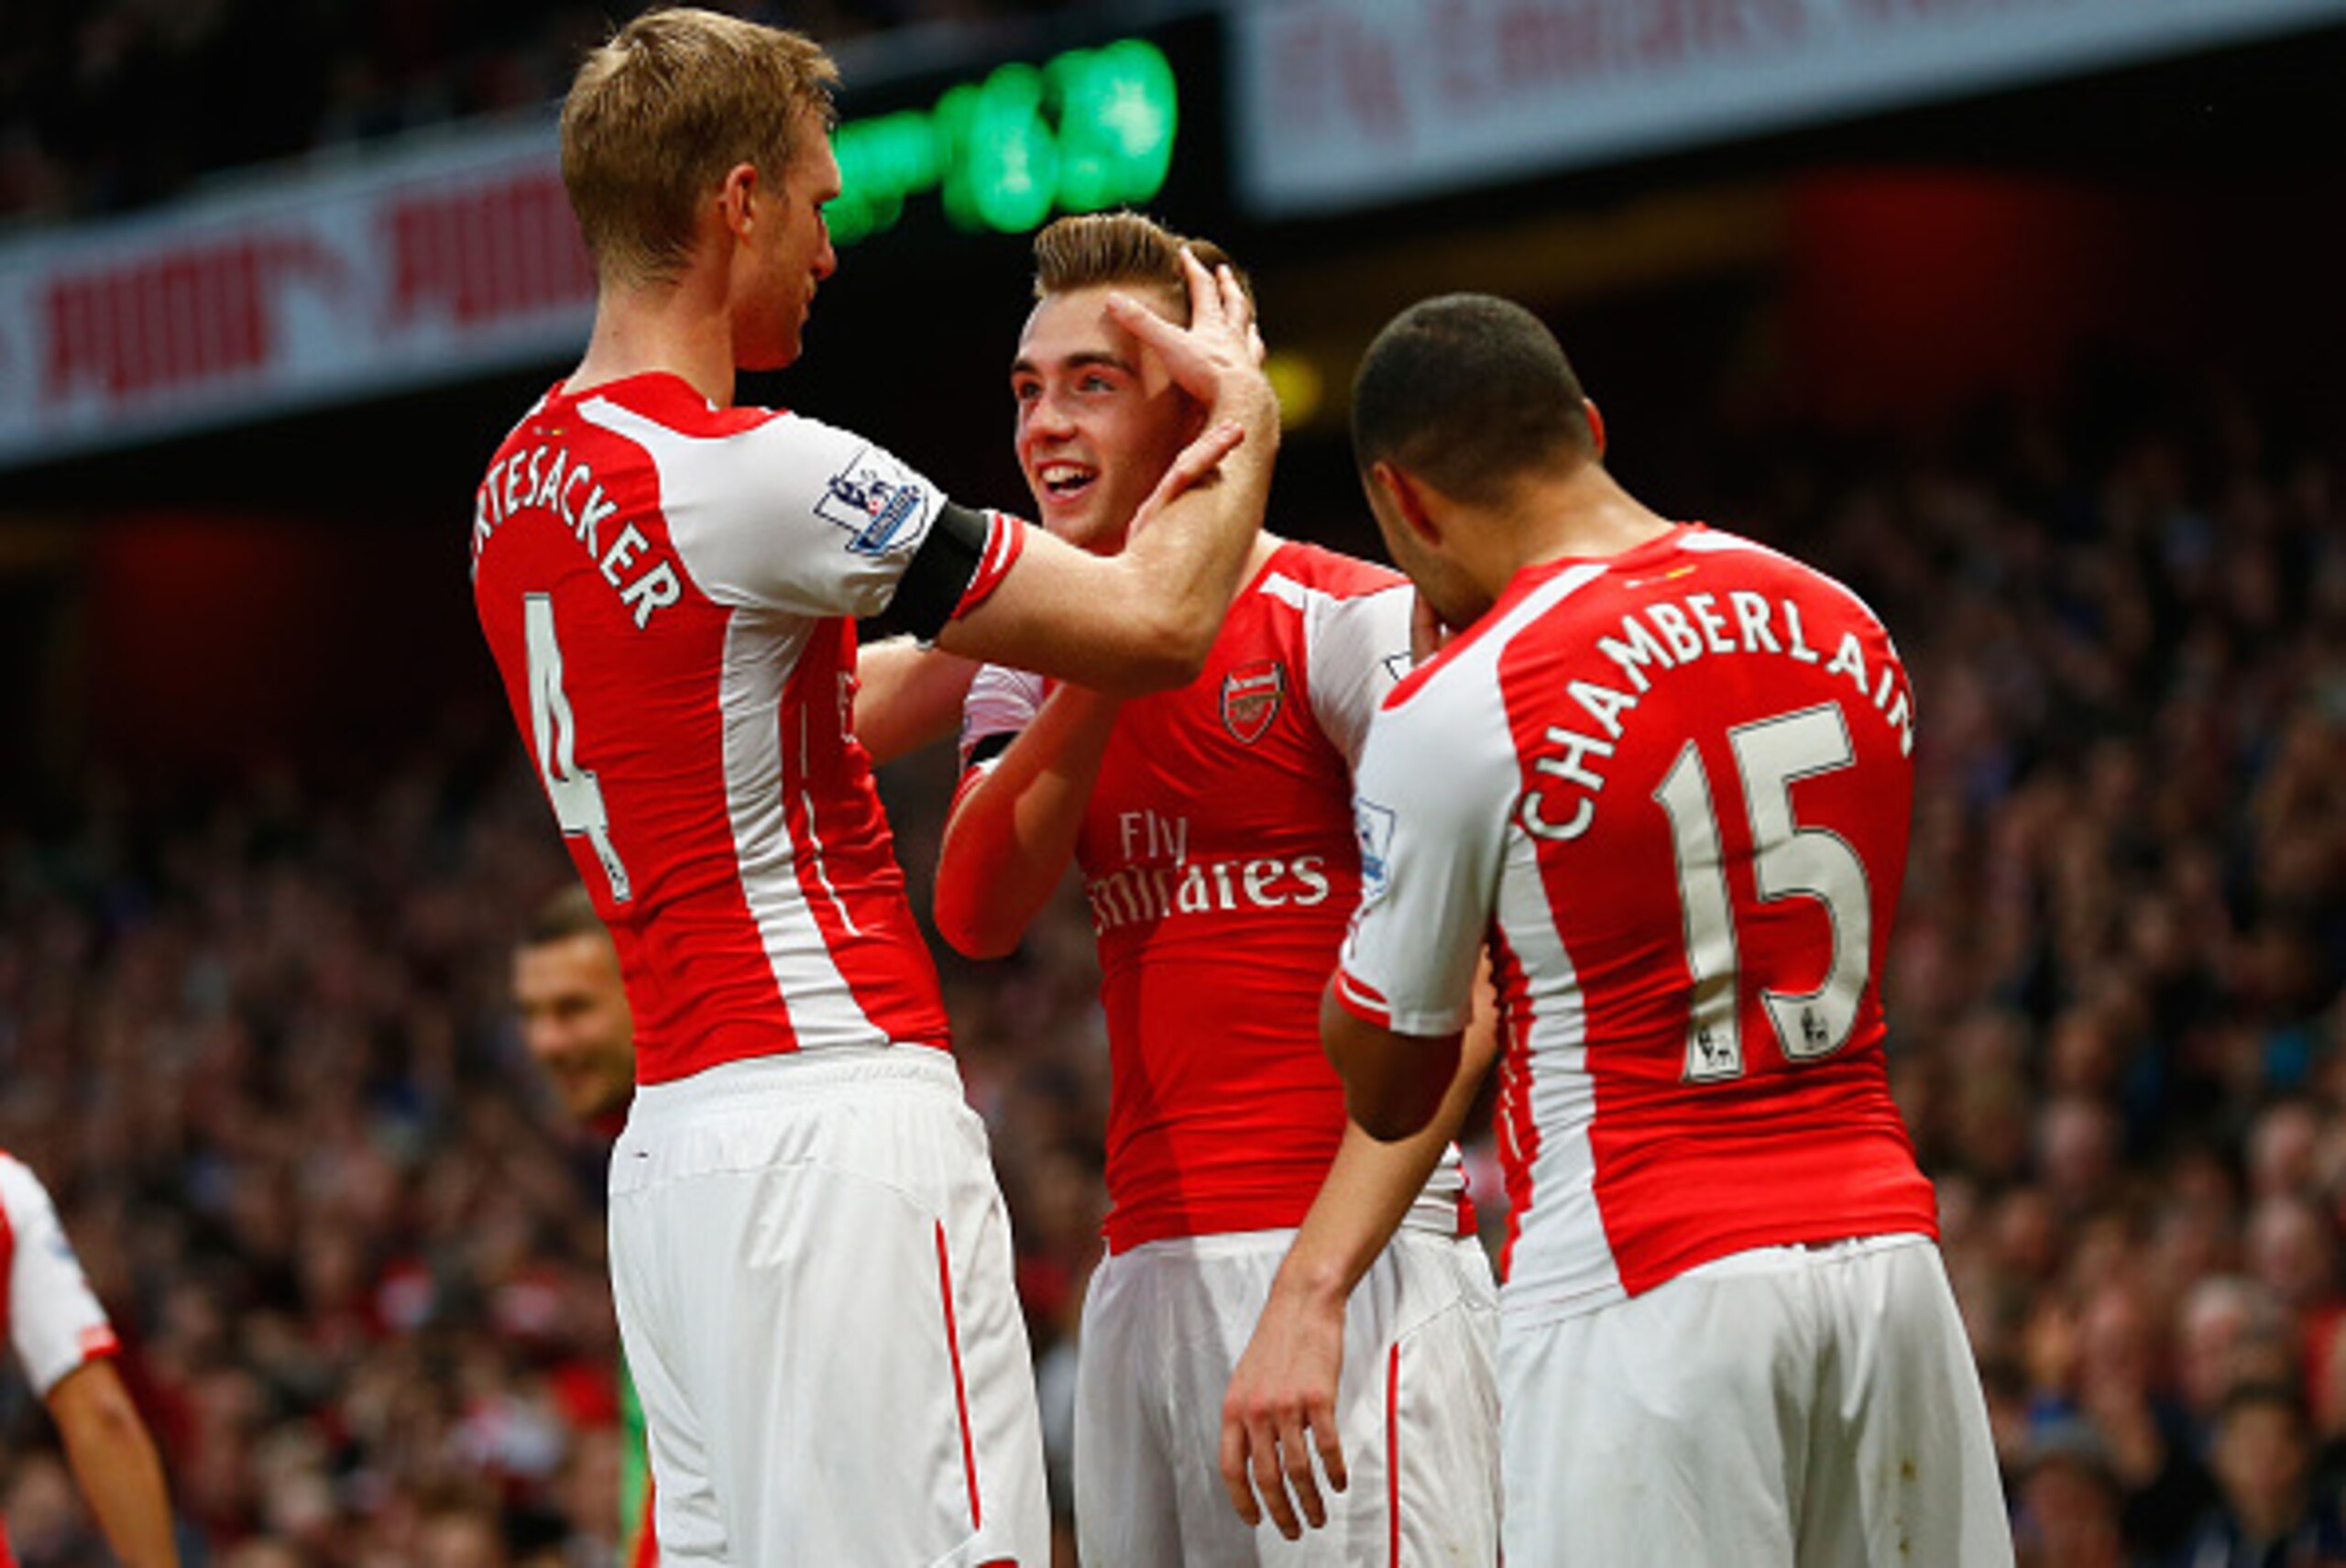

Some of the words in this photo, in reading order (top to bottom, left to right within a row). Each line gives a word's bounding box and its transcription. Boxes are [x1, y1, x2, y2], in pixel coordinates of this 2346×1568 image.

[521, 591, 632, 903] 4
[1118, 809, 1188, 868] Fly
[1521, 590, 1913, 841] CHAMBERLAIN
[1089, 854, 1330, 937] mirates
[1652, 700, 1872, 1083] 15
